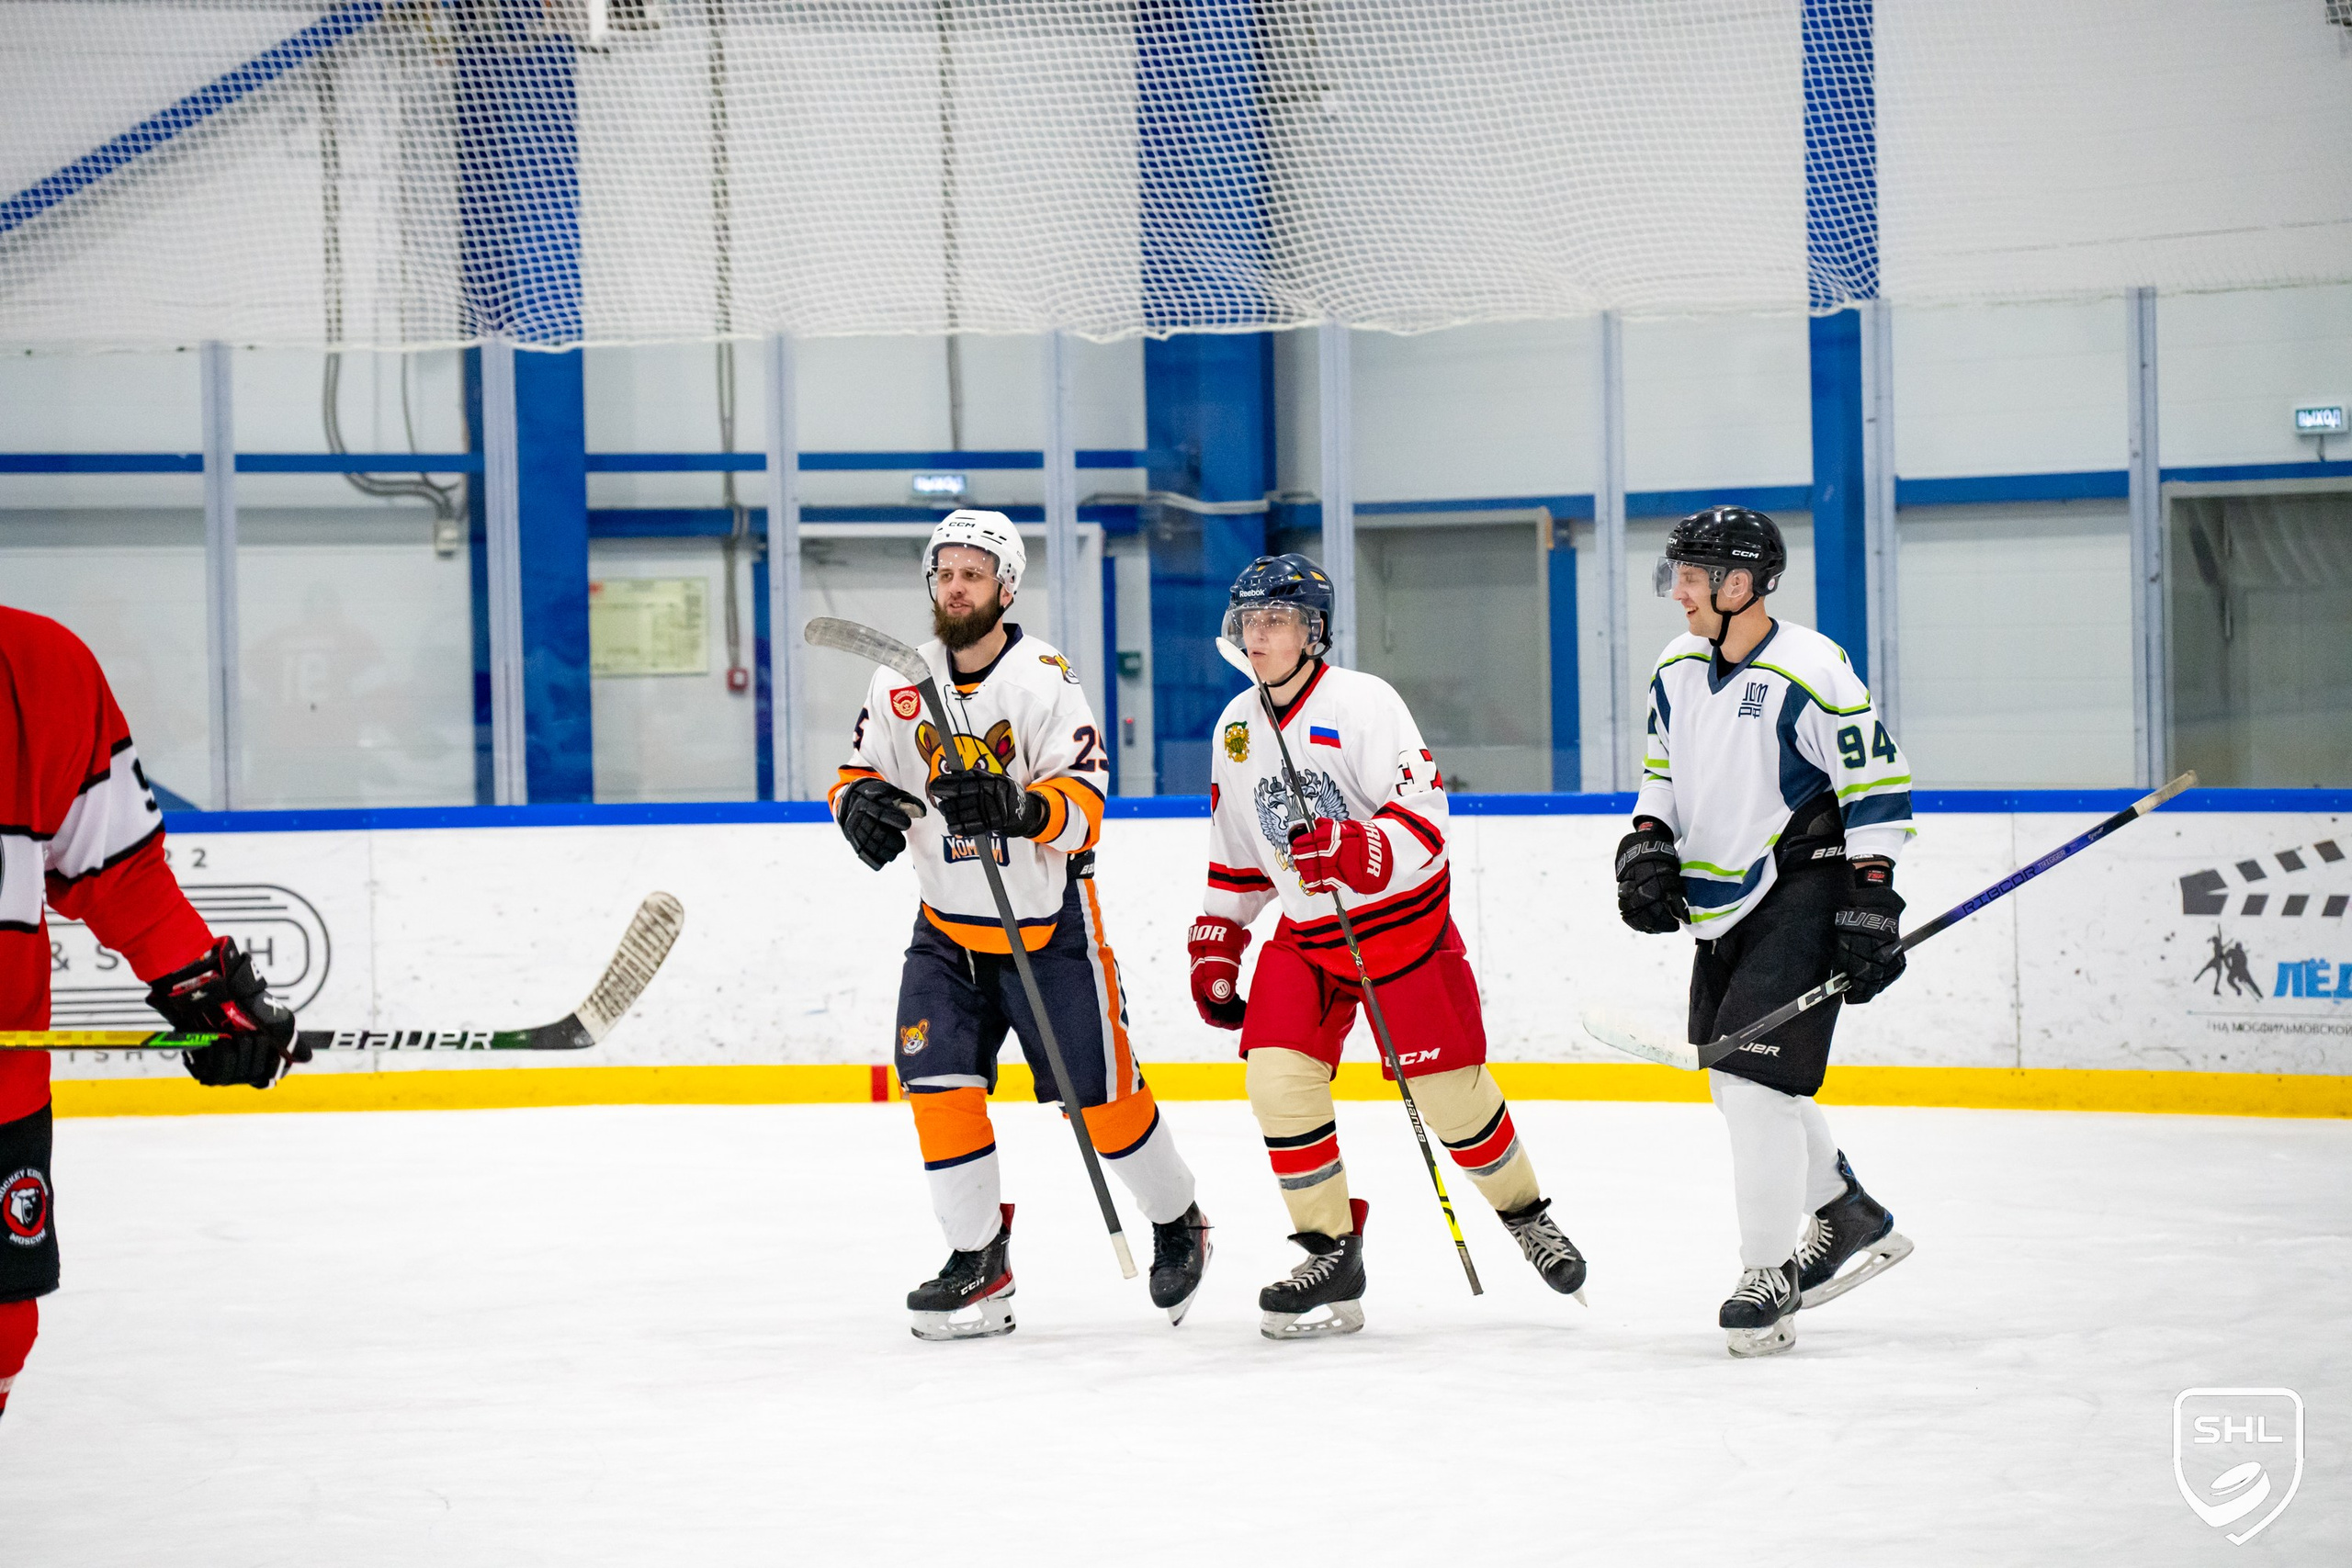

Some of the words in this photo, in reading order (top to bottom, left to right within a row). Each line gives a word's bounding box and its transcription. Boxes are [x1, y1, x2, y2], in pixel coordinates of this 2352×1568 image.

[2298, 409, 2341, 428] ВЫХОД
[1732, 549, 1759, 558] CCM
[1238, 588, 1266, 598] Reebok
[1837, 720, 1897, 769] 94
[1617, 840, 1679, 876] BAUE
[1962, 865, 2037, 915] RIBCOR
[2037, 849, 2066, 870] TRIGGER
[1835, 910, 1898, 934] AUER
[329, 1029, 495, 1051] BAUER
[1405, 1099, 1427, 1143] BAUER
[9, 1227, 46, 1246] MOSCOW
